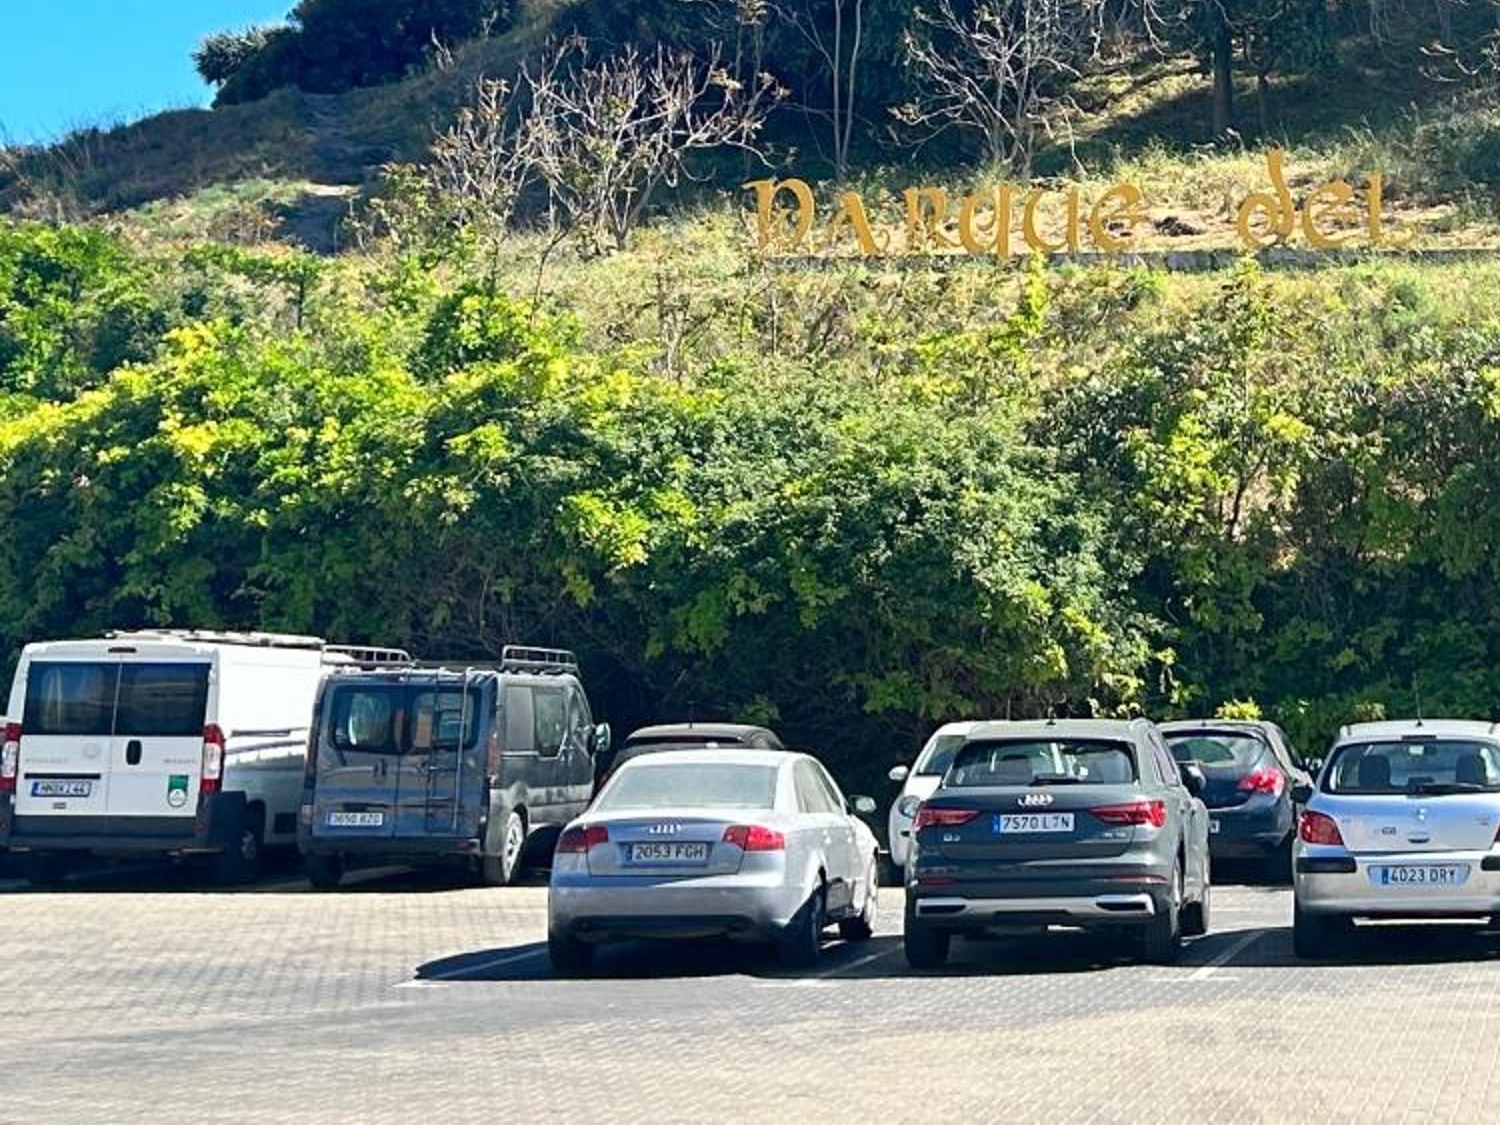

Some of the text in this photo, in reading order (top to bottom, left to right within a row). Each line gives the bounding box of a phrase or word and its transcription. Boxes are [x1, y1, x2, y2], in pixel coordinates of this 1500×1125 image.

[1238, 147, 1416, 250] del
[1003, 816, 1070, 830] 7570 LTN
[1391, 868, 1456, 884] 4023 DRY
